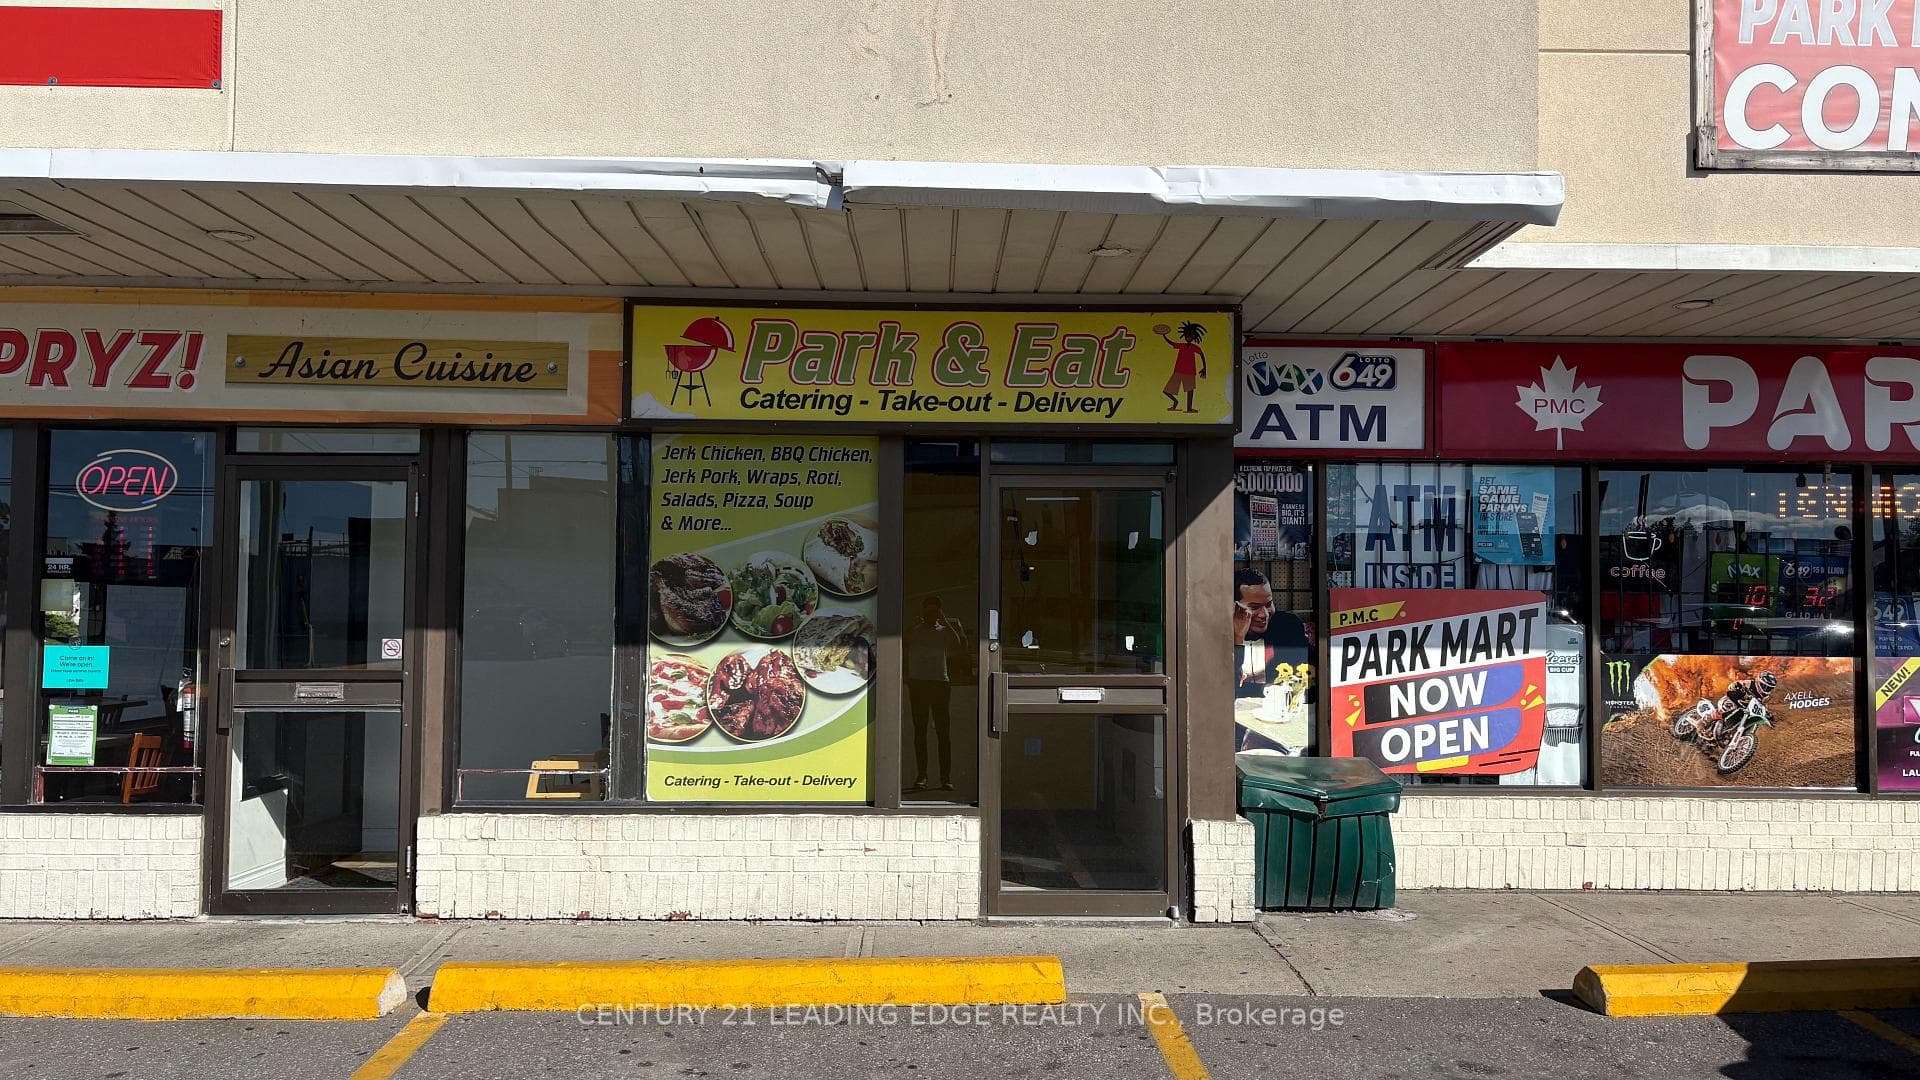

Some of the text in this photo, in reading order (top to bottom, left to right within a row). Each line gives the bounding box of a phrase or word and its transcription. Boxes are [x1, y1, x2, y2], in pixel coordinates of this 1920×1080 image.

[1738, 0, 1898, 47] PARK
[258, 341, 538, 384] Asian Cuisine
[740, 317, 1136, 390] Park & Eat
[1243, 351, 1269, 366] Lotto
[1248, 360, 1322, 395] MAX
[1332, 354, 1393, 389] 649
[740, 386, 851, 415] Catering
[877, 389, 991, 413] Take-out
[1014, 391, 1124, 419] Delivery
[1533, 398, 1586, 415] PMC
[1682, 354, 1920, 452] PAR
[1250, 403, 1387, 442] ATM
[661, 445, 873, 464] Jerk Chicken, BBQ Chicken,
[81, 465, 168, 496] OPEN
[661, 468, 842, 487] Jerk Pork, Wraps, Roti,
[1480, 476, 1496, 485] BET
[661, 492, 814, 510] Salads, Pizza, Soup
[1479, 486, 1518, 495] SAME
[1479, 495, 1520, 503] GAME
[1365, 484, 1456, 552] ATM
[1479, 504, 1528, 512] PARLAYS
[661, 515, 732, 531] & More...
[1281, 517, 1305, 525] GIANT!
[1365, 563, 1456, 589] INSIDE
[1339, 608, 1379, 626] P.M.C
[1340, 608, 1539, 681] PARK MART
[1881, 666, 1911, 697] NEW!
[1388, 671, 1488, 718] NOW
[1784, 691, 1813, 701] AXELL
[1789, 698, 1830, 709] HODGES
[1380, 716, 1489, 762] OPEN
[664, 775, 721, 788] Catering
[733, 775, 791, 786] Take-out
[802, 775, 857, 788] Delivery
